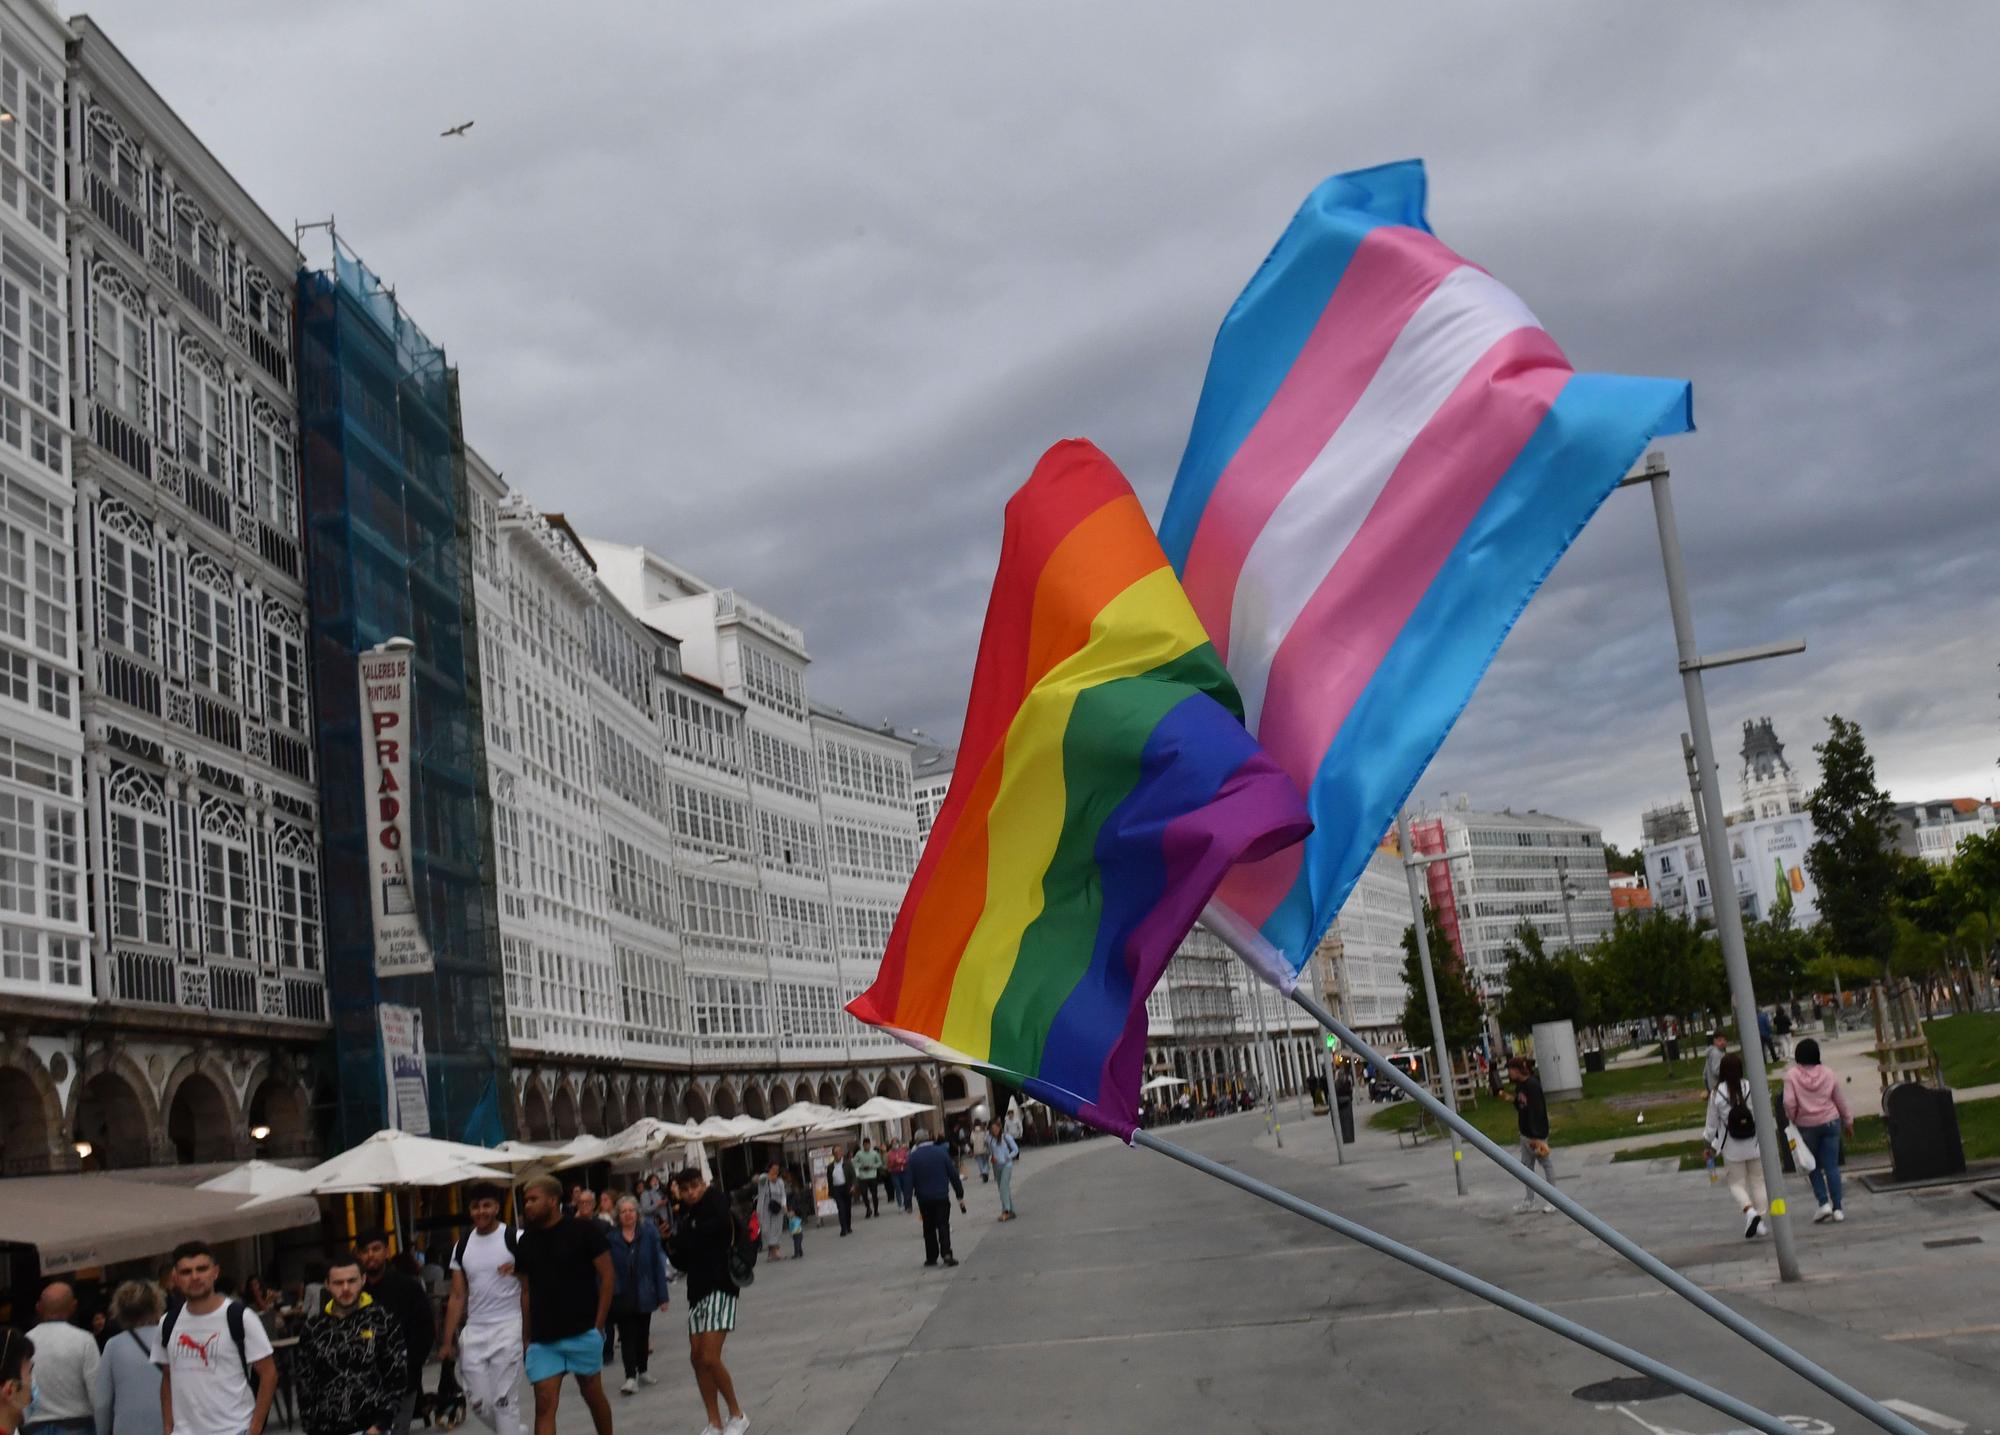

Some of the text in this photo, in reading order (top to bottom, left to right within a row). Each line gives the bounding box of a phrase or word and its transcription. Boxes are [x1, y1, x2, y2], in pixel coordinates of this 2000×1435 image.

[362, 660, 406, 680] TALLERES DE
[367, 683, 401, 702] PINTURAS
[373, 712, 401, 850] PRADO
